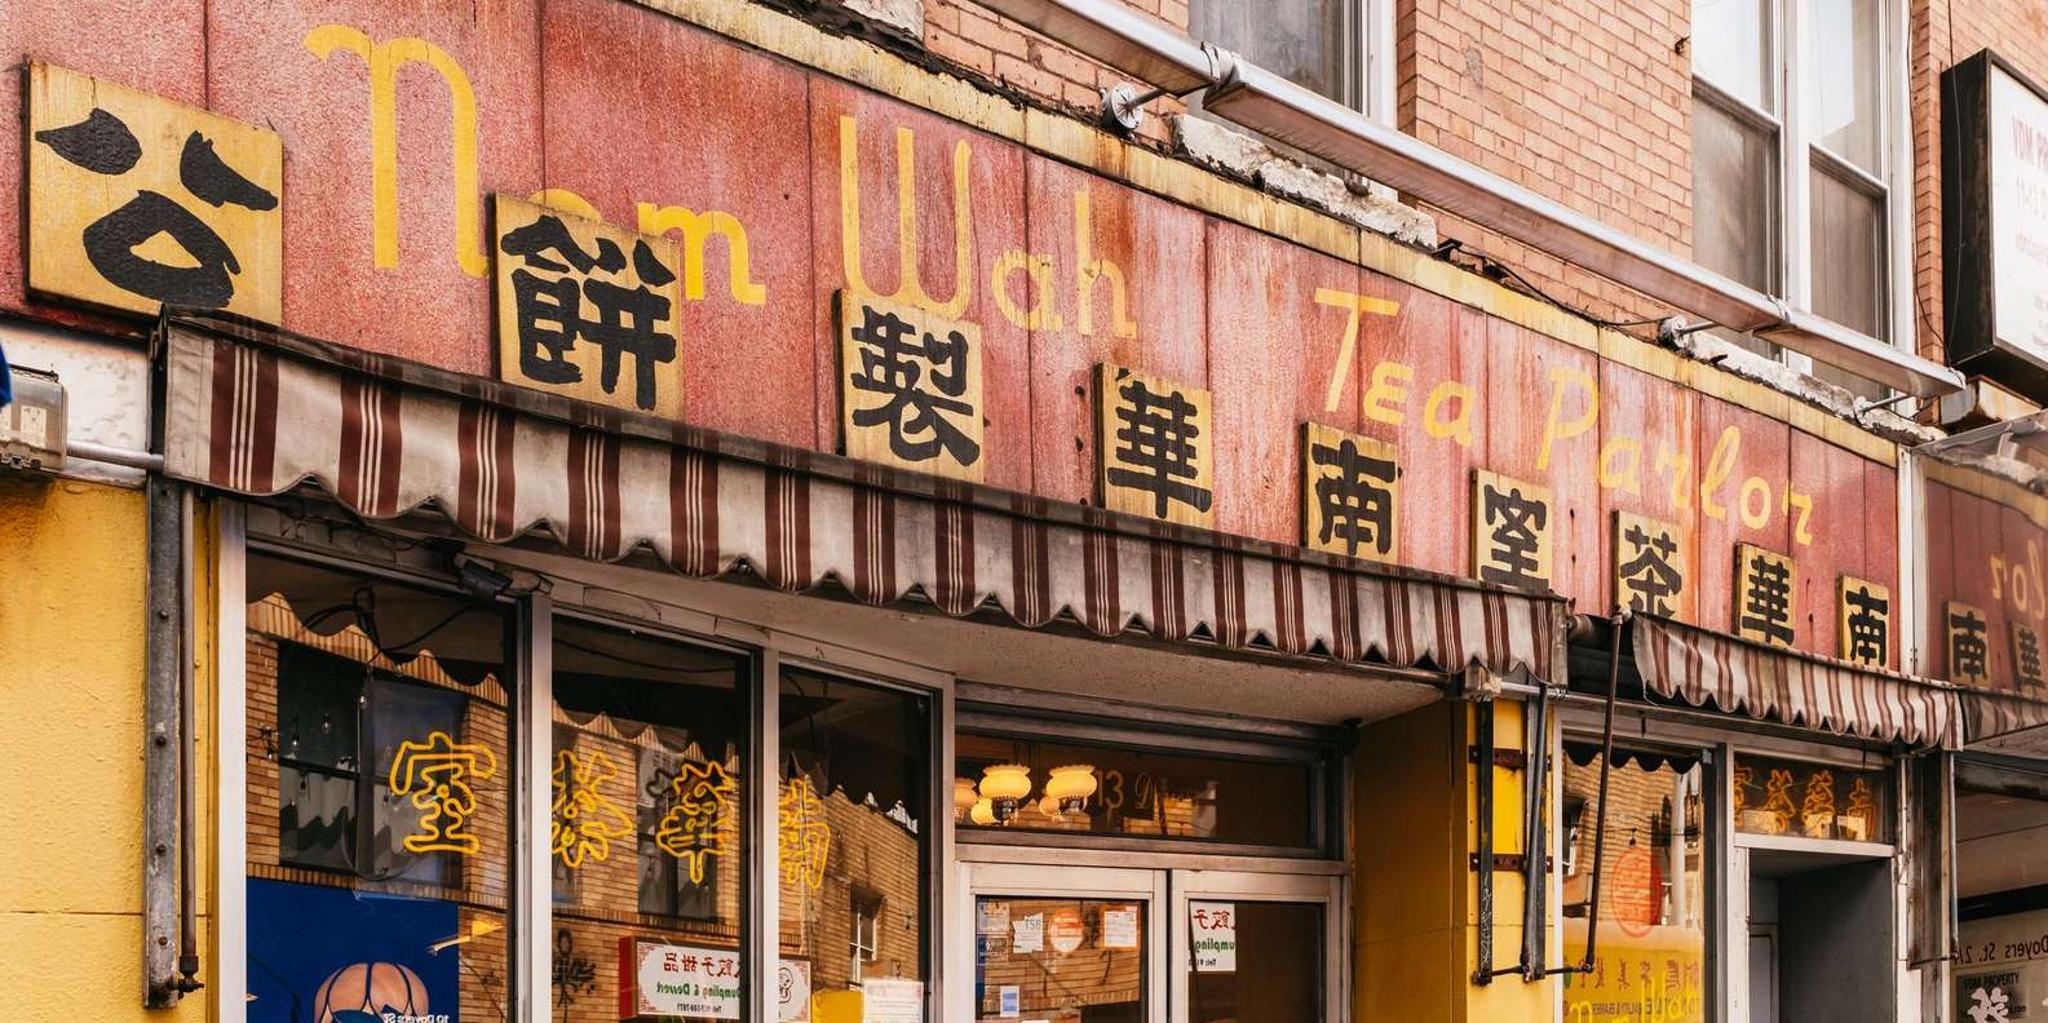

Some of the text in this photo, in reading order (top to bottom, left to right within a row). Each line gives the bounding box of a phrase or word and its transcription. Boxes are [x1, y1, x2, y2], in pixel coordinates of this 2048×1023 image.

[303, 24, 1814, 547] Nm Wah Tea Parlor
